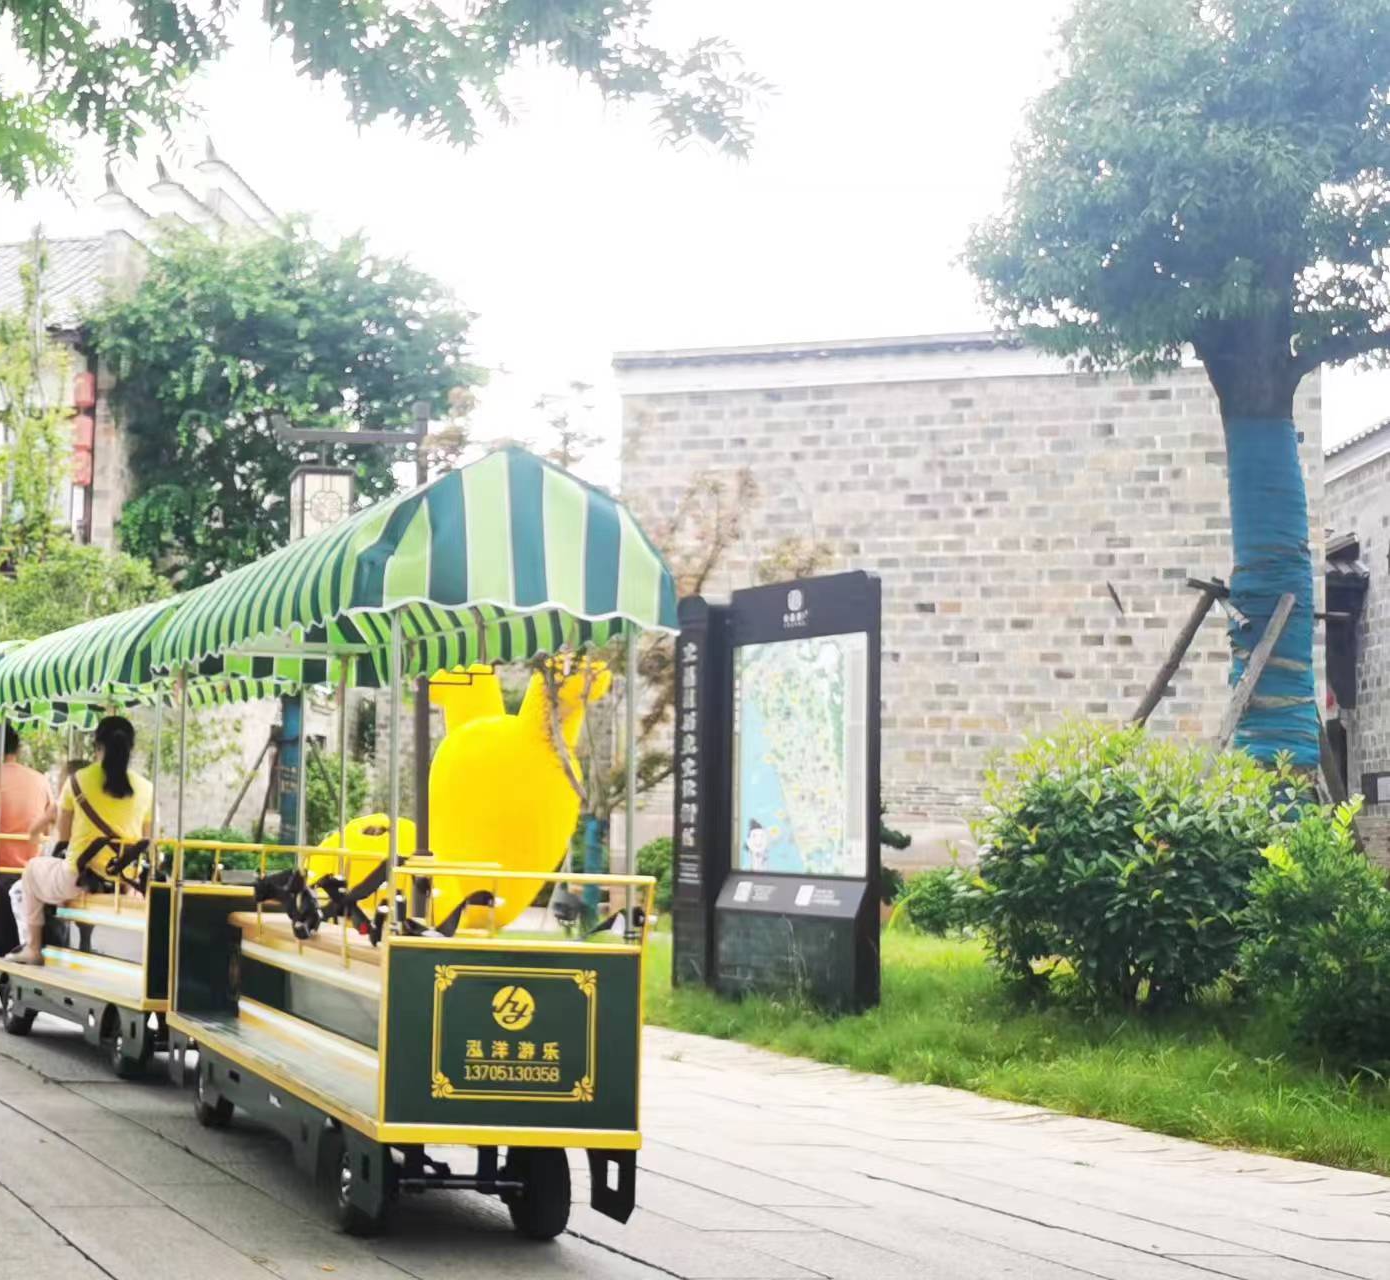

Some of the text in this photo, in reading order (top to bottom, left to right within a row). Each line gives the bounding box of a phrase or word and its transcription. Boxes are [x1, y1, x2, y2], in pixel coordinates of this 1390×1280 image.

[466, 1040, 560, 1061] 泓洋游乐
[464, 1065, 560, 1082] 13705130358
